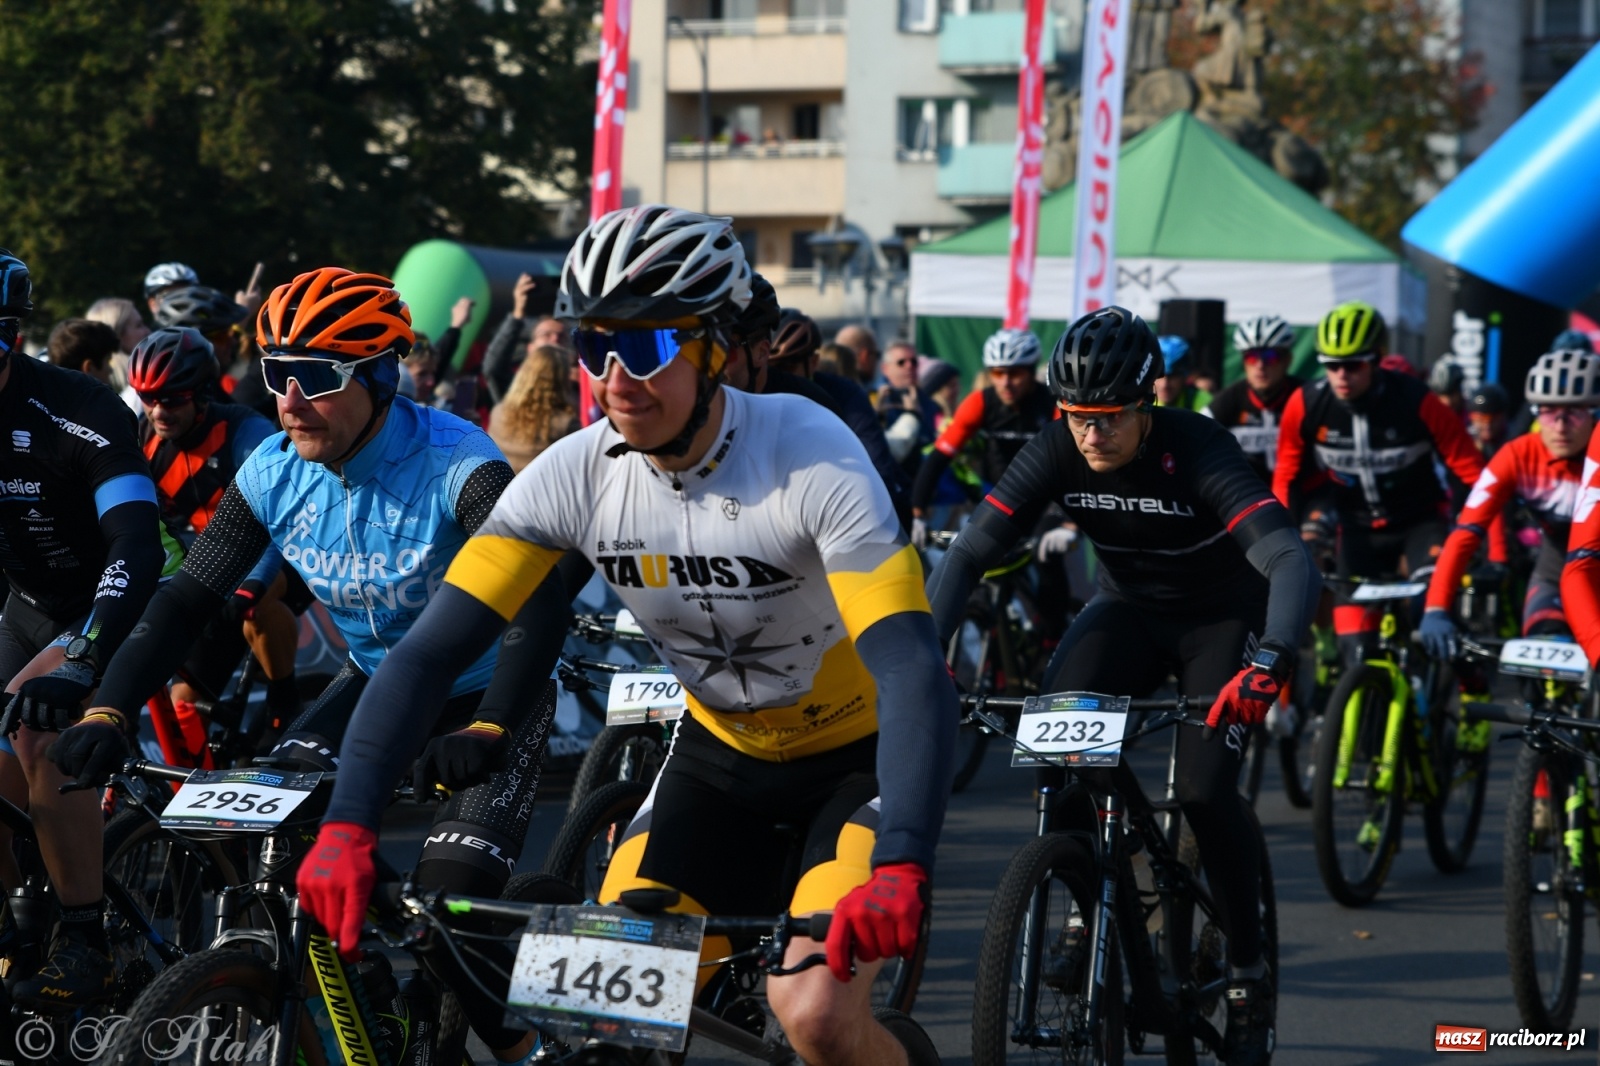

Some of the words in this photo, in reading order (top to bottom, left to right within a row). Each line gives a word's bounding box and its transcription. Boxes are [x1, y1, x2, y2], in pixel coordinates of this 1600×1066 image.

[0, 478, 41, 495] telier
[612, 539, 647, 551] Sobik
[282, 543, 388, 580] POWER
[396, 543, 436, 578] OF
[596, 553, 740, 590] TAURUS
[308, 563, 446, 611] CIENCE
[802, 634, 815, 647] E
[1518, 644, 1576, 663] 2179
[623, 681, 682, 703] 1790
[784, 680, 803, 692] SE
[1033, 720, 1106, 743] 2232
[493, 768, 523, 808] Power
[518, 747, 532, 768] of
[526, 703, 554, 750] Science
[186, 791, 284, 815] 2956
[312, 830, 352, 880] FOX
[864, 873, 901, 915] FOX
[546, 956, 666, 1008] 1463
